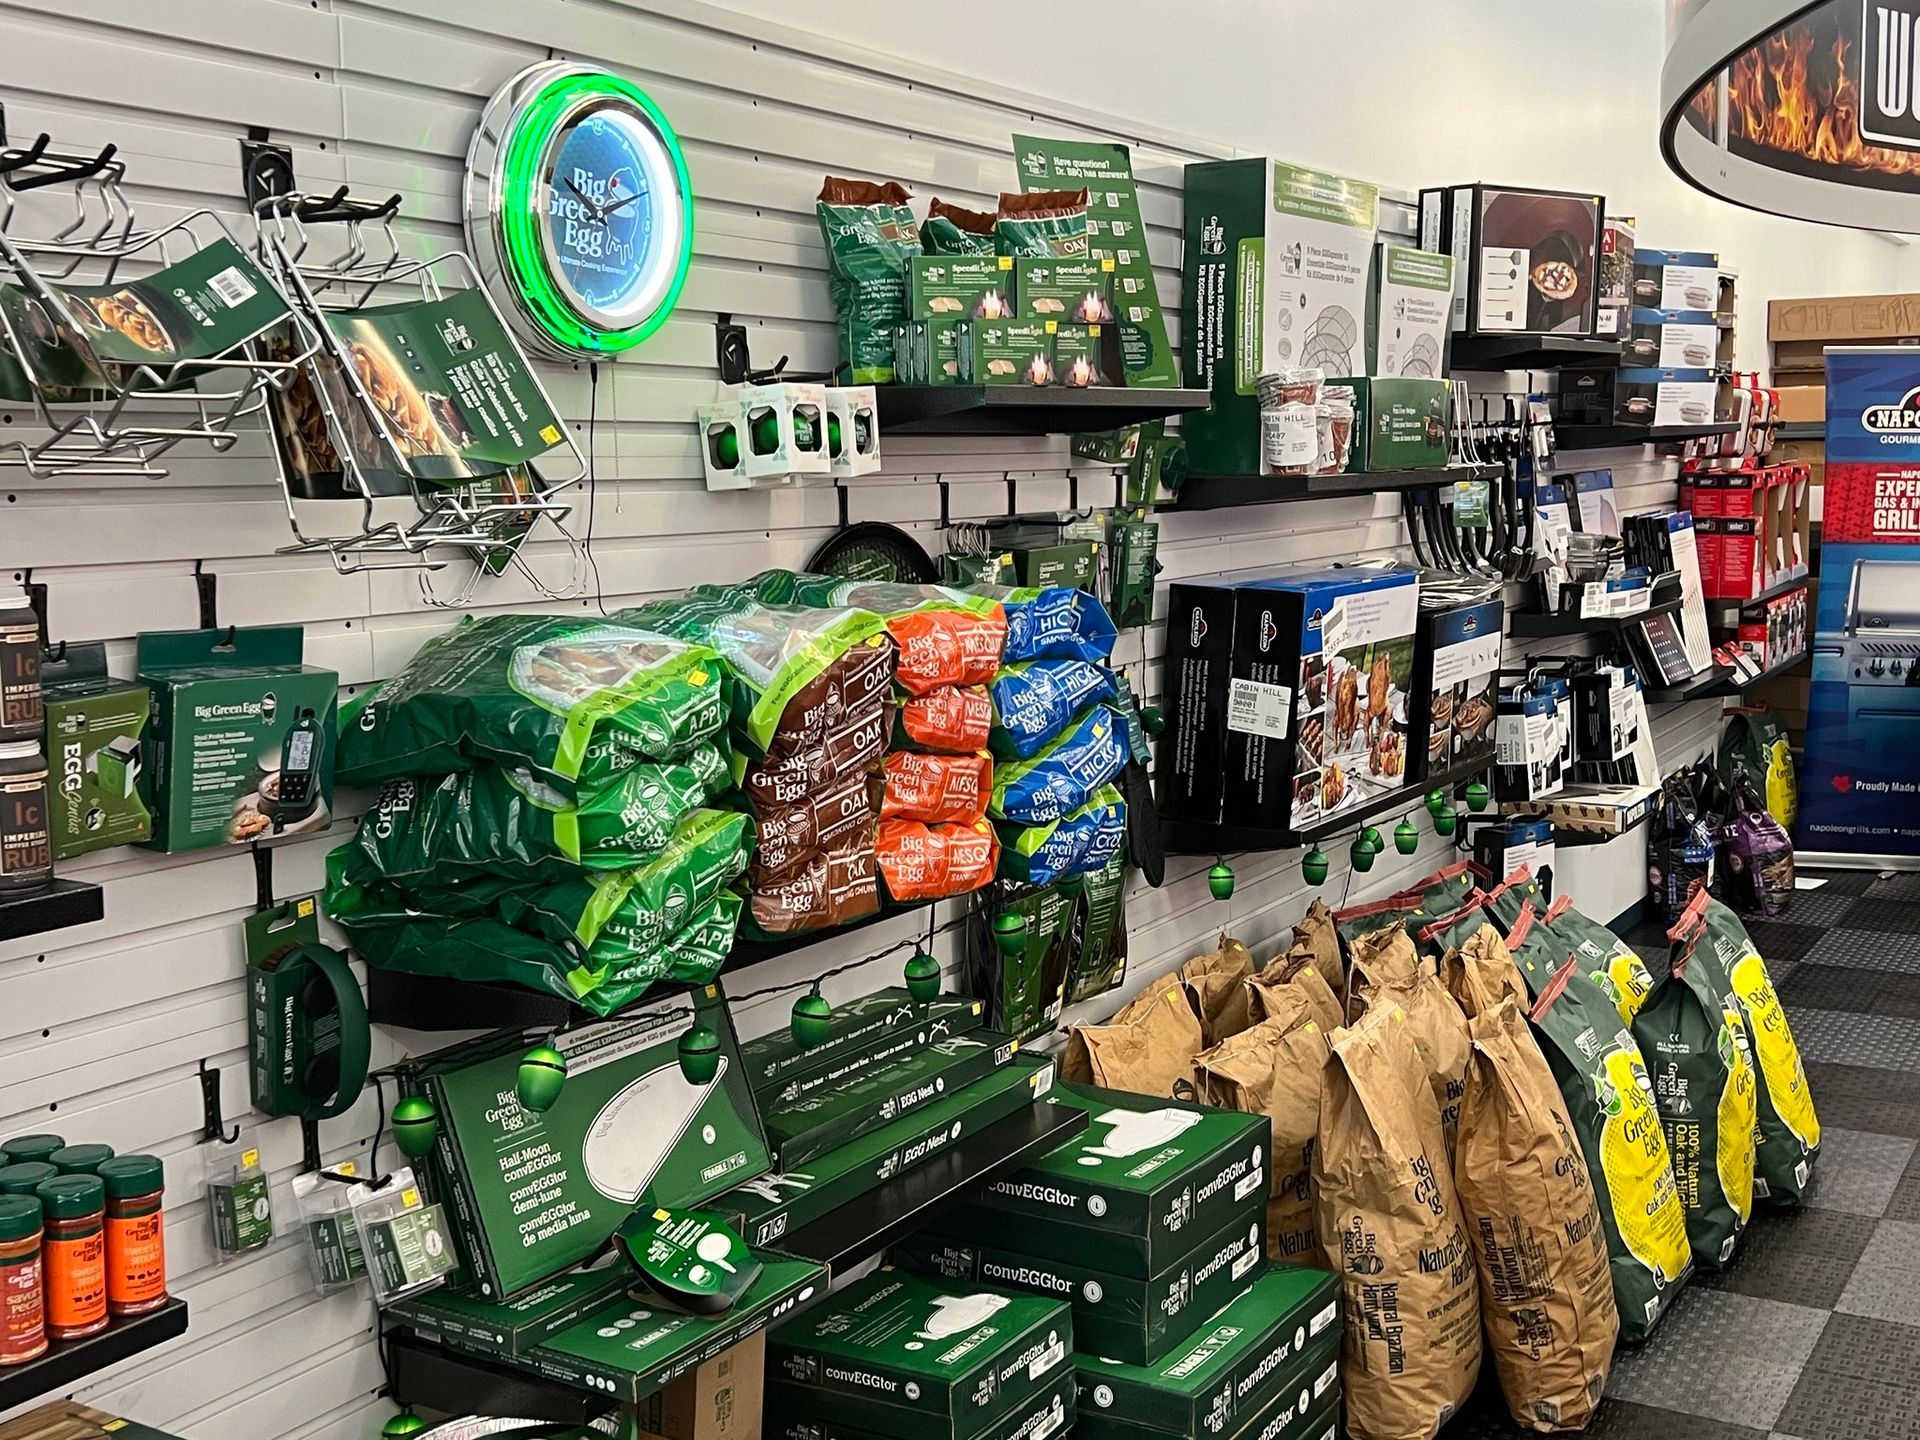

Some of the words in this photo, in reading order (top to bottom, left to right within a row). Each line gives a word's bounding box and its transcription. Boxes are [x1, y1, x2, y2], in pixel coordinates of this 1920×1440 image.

[1054, 157, 1071, 167] Have
[1073, 160, 1110, 170] questions?
[1055, 166, 1066, 176] Dr.
[1067, 168, 1083, 178] BBQ
[1084, 169, 1097, 178] has
[1098, 170, 1129, 180] answers!
[573, 167, 606, 206] Big
[563, 219, 603, 258] Egg
[1064, 239, 1088, 253] OAK
[1874, 498, 1897, 509] GAS
[1900, 498, 1910, 509] &
[1262, 614, 1270, 649] NAPOLEON
[908, 636, 934, 653] Big
[16, 653, 36, 677] Ic
[864, 662, 891, 691] OAK
[1012, 689, 1039, 709] Big
[1234, 682, 1260, 693] CABIN
[1262, 687, 1282, 698] HILL
[195, 706, 212, 718] Big
[212, 704, 242, 716] Green
[243, 702, 263, 716] Egg
[804, 702, 825, 727] Big
[927, 708, 948, 728] Egg
[1002, 702, 1045, 729] Green
[853, 718, 881, 750] OAK
[64, 742, 83, 791] EGG
[902, 754, 925, 775] Big
[774, 782, 808, 802] Egg
[894, 784, 919, 804] Egg
[1032, 785, 1056, 806] Big
[1856, 780, 1890, 793] Proudly
[1891, 782, 1916, 793] Made
[15, 801, 39, 827] Ic
[58, 780, 83, 836] Genius
[618, 800, 649, 829] Big
[840, 790, 870, 817] OAK
[598, 815, 658, 848] Green
[630, 826, 668, 852] Egg
[762, 818, 787, 841] Big
[1053, 830, 1075, 845] Big
[1810, 824, 1891, 835] napoleongrills.com
[6, 845, 49, 868] RUB
[900, 836, 925, 853] Big
[760, 847, 787, 868] Egg
[878, 851, 925, 866] Green
[898, 864, 925, 882] Egg
[781, 894, 813, 913] Egg
[606, 921, 664, 938] Green
[635, 910, 664, 926] Big
[284, 996, 295, 1014] Big
[285, 1013, 295, 1043] Green
[575, 1040, 602, 1055] ULTIMATE
[602, 1030, 632, 1046] EXPANSION
[632, 1021, 653, 1036] SYSTEM
[652, 1017, 664, 1027] FOR
[284, 1042, 295, 1062] Egg
[568, 1058, 588, 1072] ystème
[588, 1048, 617, 1065] d'extension
[647, 1032, 659, 1042] EGG
[1656, 1046, 1672, 1054] MADE
[1667, 1042, 1690, 1050] NATURAL
[1658, 1074, 1668, 1095] Egg
[1668, 1062, 1679, 1097] Green
[1677, 1078, 1688, 1097] Big
[496, 1090, 517, 1106] Big
[901, 1091, 918, 1109] EGG
[918, 1084, 935, 1101] Nest
[486, 1103, 520, 1123] Green
[501, 1114, 524, 1131] Egg
[1624, 1106, 1654, 1144] Green
[904, 1142, 926, 1164] EGG
[926, 1130, 948, 1152] Nest
[1676, 1124, 1688, 1148] Oak
[1688, 1124, 1700, 1158] 100%
[499, 1143, 551, 1171] Half-Moon
[504, 1151, 562, 1183] convEGGtor
[1676, 1151, 1686, 1176] and
[703, 1161, 729, 1181] FRAGILE
[1197, 1158, 1249, 1204] convEGGtor
[510, 1170, 568, 1203] convEGGtor
[1688, 1160, 1701, 1209] Natural
[513, 1186, 563, 1216] demi-lune
[518, 1201, 577, 1235] convEGGtor
[522, 1232, 537, 1248] de
[538, 1218, 569, 1242] media
[568, 1208, 592, 1227] luna
[1163, 1208, 1182, 1227] Green
[1352, 1215, 1364, 1254] Green
[1365, 1233, 1376, 1254] Big
[1194, 1236, 1246, 1287] convEGGtor
[983, 1263, 1074, 1293] convEGGtor
[1485, 1262, 1508, 1303] Natural
[1502, 1246, 1527, 1305] Hardwood
[1160, 1291, 1180, 1311] Green
[1380, 1283, 1402, 1323] Natural
[632, 1328, 669, 1349] FRAGILE
[1386, 1326, 1406, 1374] Brazilian
[945, 1341, 977, 1363] FRAGILE
[1000, 1342, 1046, 1382] convEGGtor
[1168, 1348, 1210, 1377] FRAGILE
[826, 1367, 897, 1392] convEGGtor
[1238, 1340, 1291, 1398] convEGGtor
[1099, 1392, 1109, 1401] XL
[1204, 1407, 1223, 1427] Green
